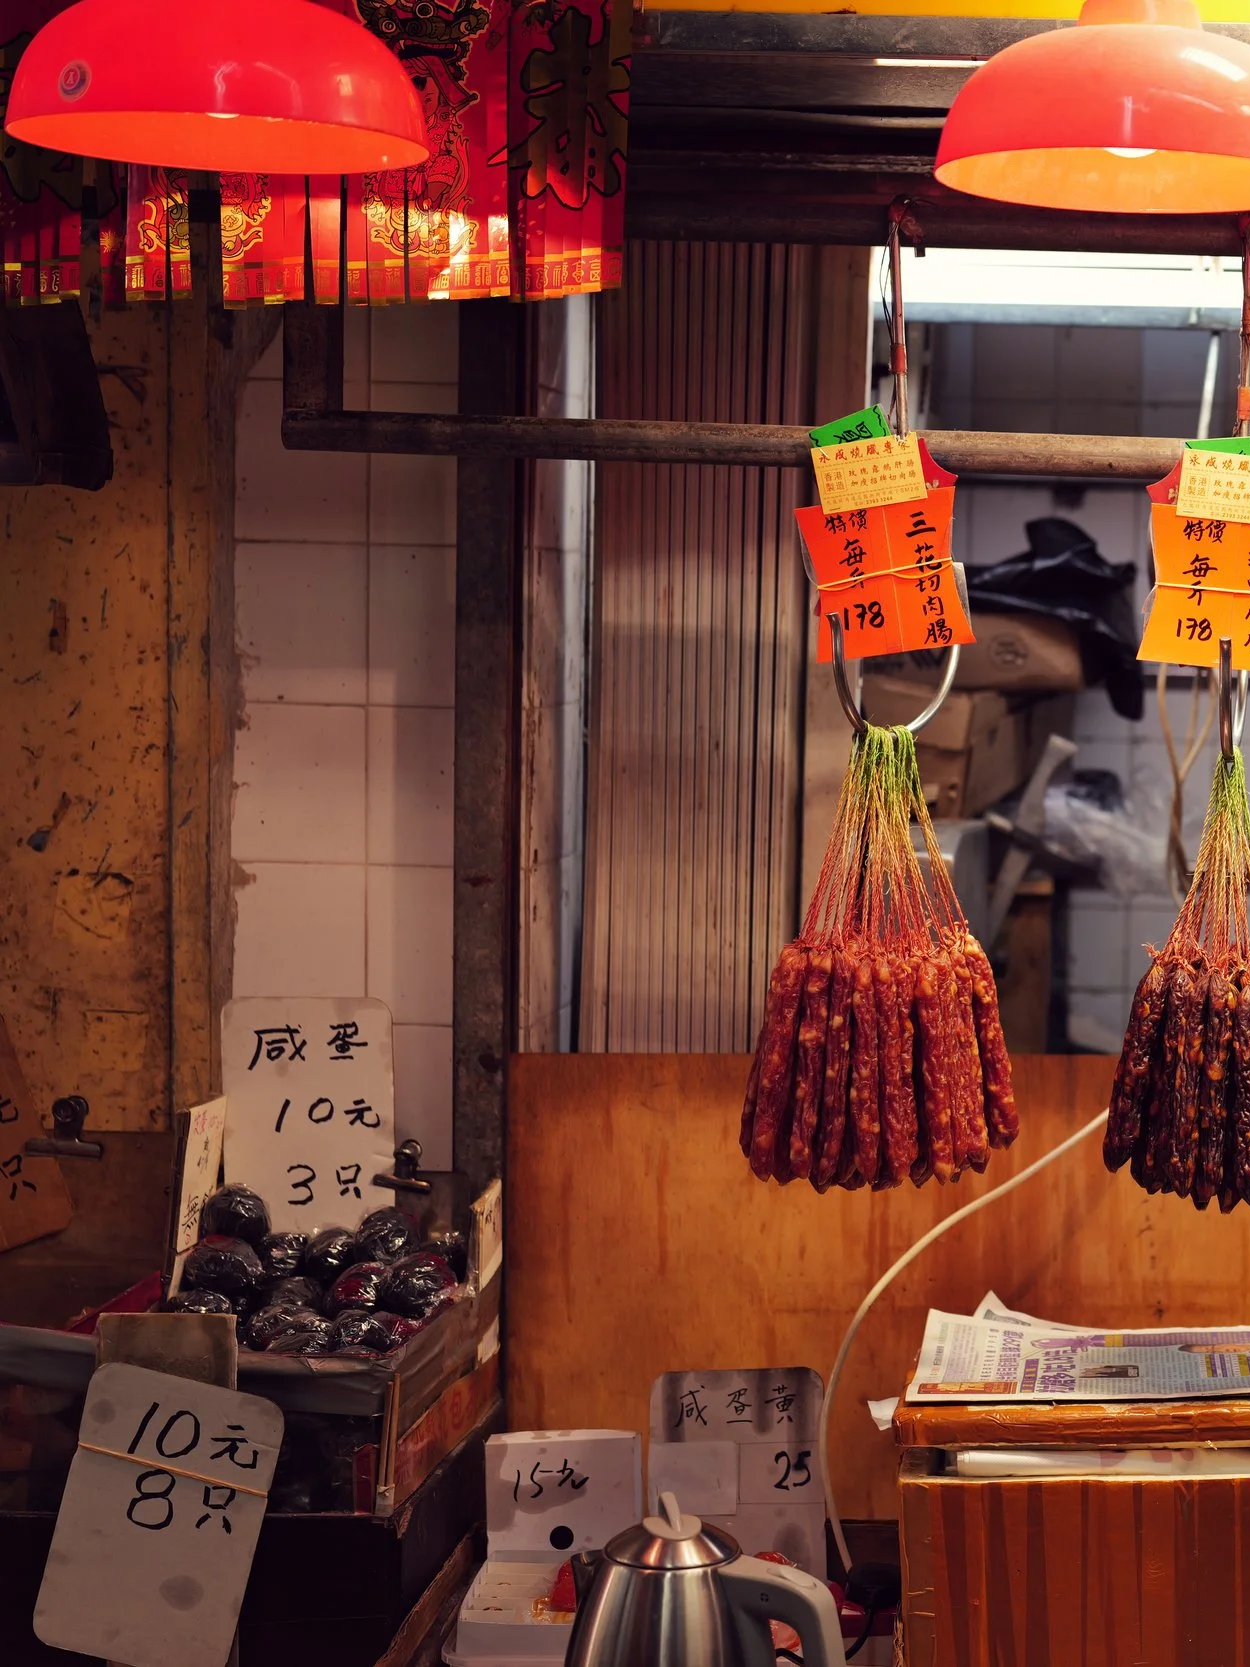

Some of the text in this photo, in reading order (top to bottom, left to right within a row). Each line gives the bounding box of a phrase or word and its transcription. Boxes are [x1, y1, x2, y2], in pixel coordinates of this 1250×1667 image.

[824, 509, 868, 535] 特價
[1183, 520, 1227, 543] 特價
[839, 538, 866, 589] 每斤
[906, 511, 953, 645] 三花切肉腸
[1182, 554, 1218, 606] 每斤
[843, 601, 885, 631] 178
[1176, 618, 1213, 642] 178
[274, 1097, 381, 1133] 10元
[287, 1164, 362, 1206] 3只
[127, 1402, 259, 1469] 10元
[773, 1450, 812, 1491] 25
[126, 1469, 236, 1535] 8只
